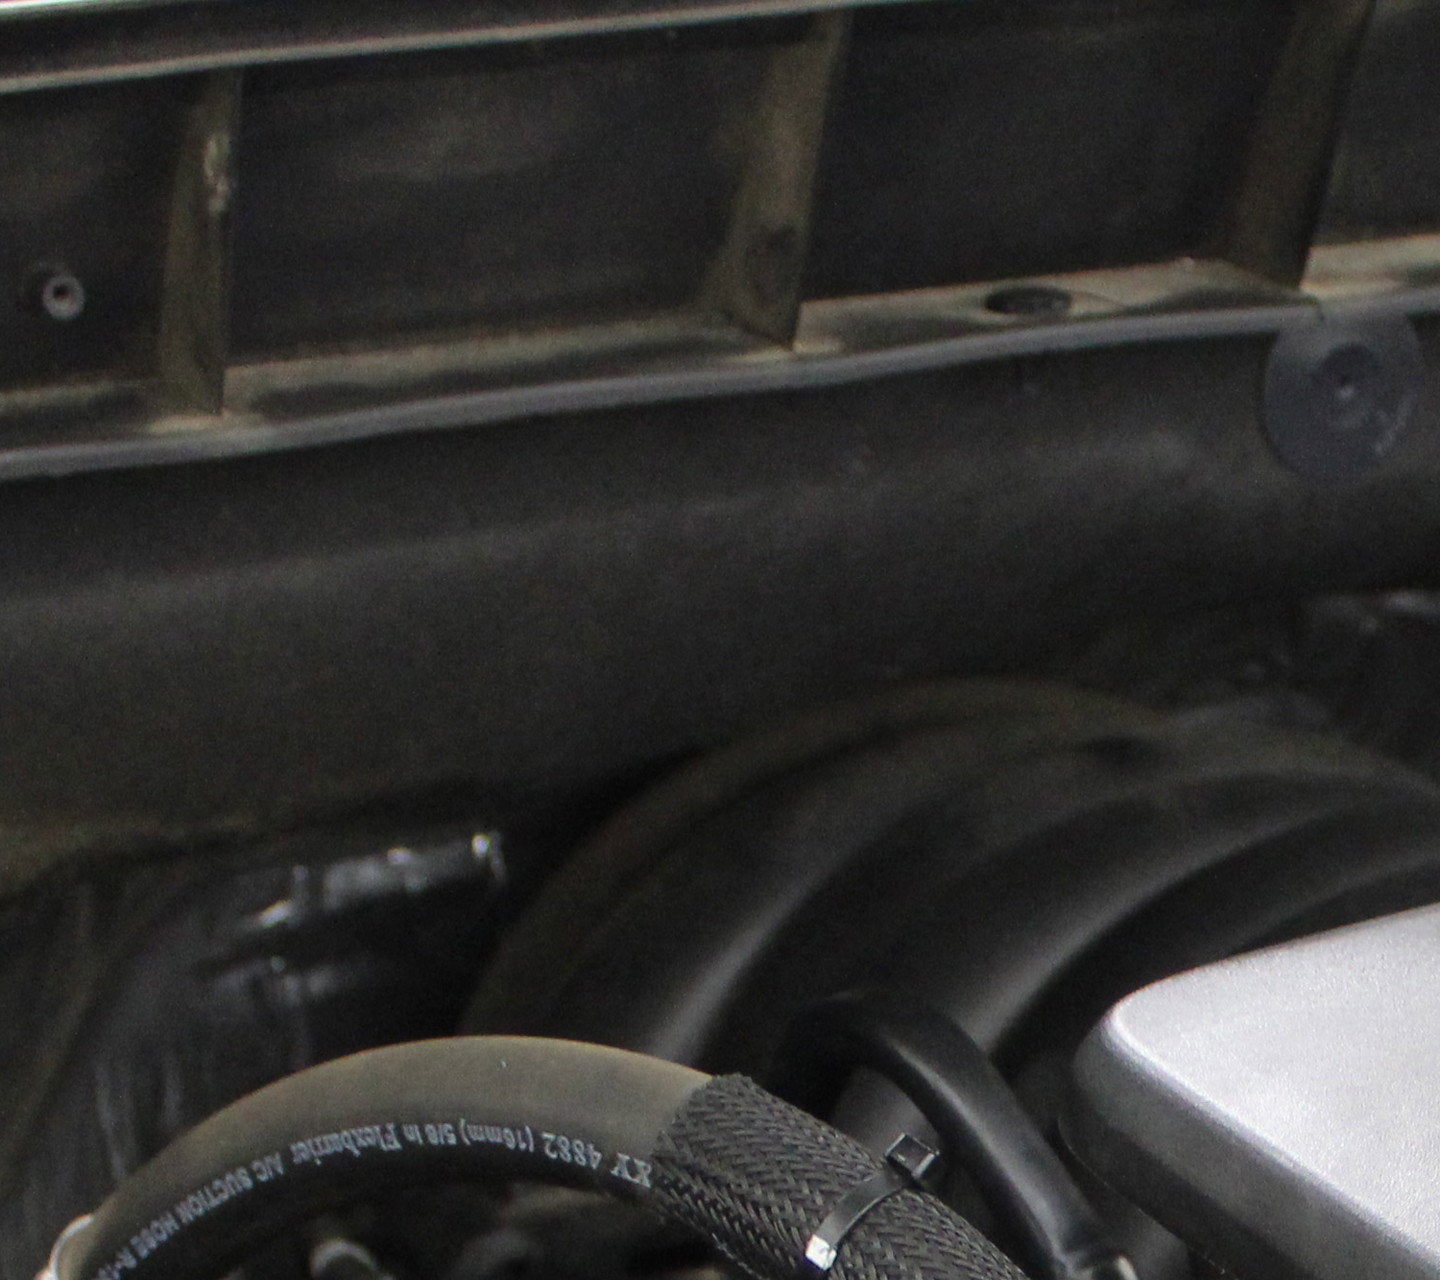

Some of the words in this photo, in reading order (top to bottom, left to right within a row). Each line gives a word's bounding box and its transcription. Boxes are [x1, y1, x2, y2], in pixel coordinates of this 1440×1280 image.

[424, 1123, 457, 1146] 5/8
[460, 1117, 535, 1153] (16mm)
[540, 1131, 603, 1170] 4882
[174, 1166, 254, 1225] SUCTION
[129, 1210, 180, 1260] HOSE
